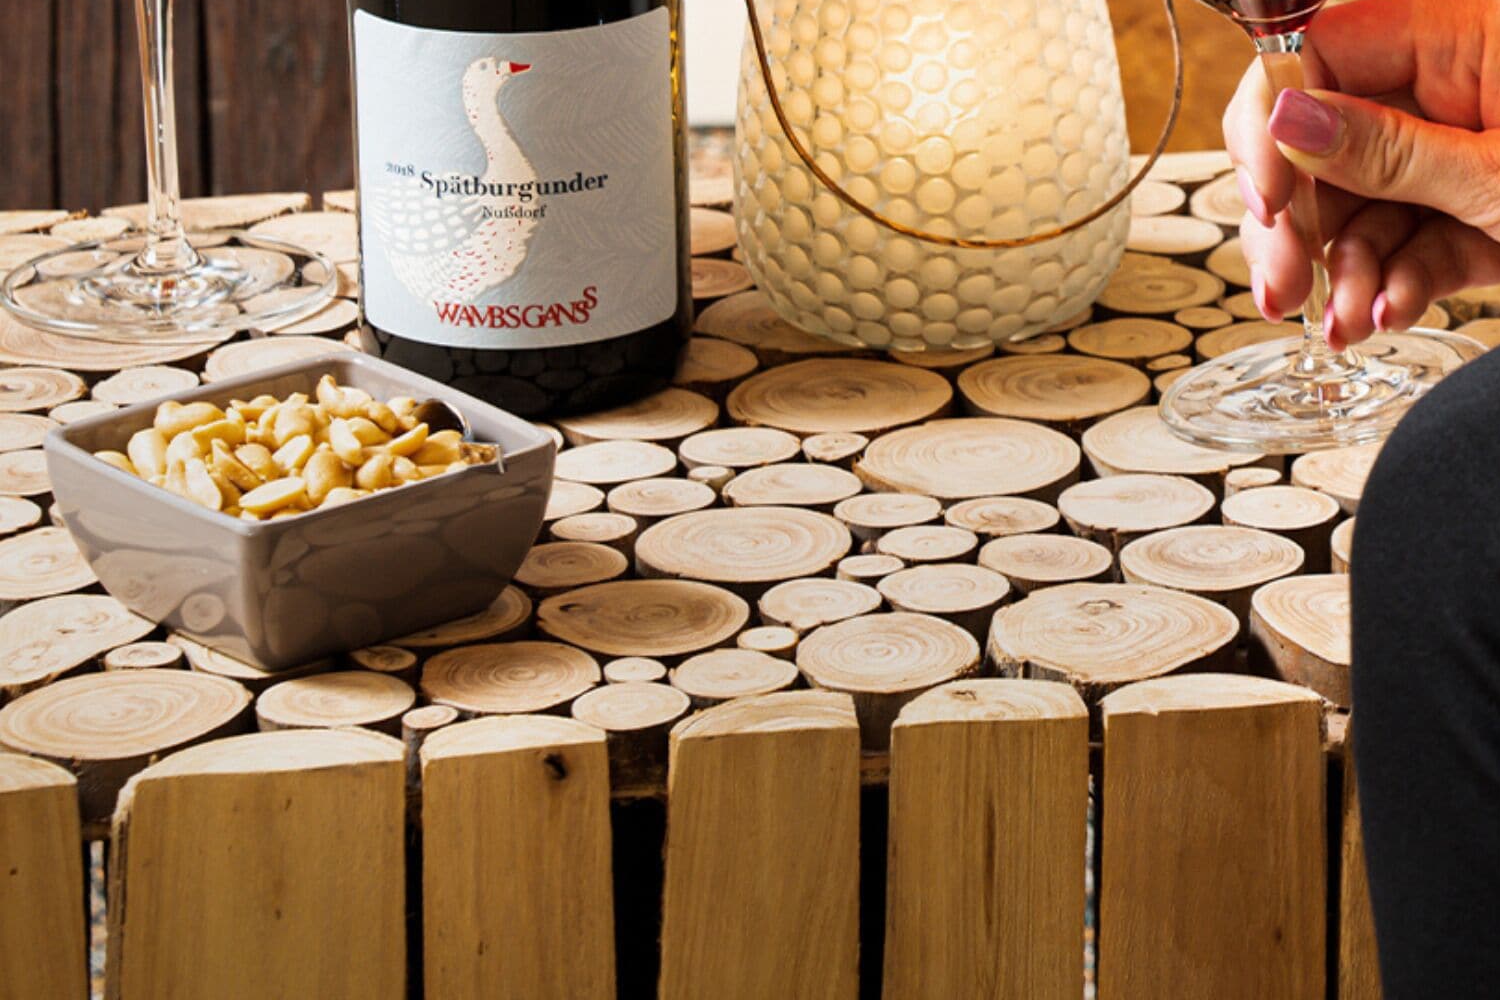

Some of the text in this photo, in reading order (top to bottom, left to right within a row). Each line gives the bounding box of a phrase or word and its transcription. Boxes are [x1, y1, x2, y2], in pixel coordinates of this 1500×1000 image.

[386, 161, 609, 203] 2018 Spätburgunder
[481, 204, 548, 220] Nußdorf
[433, 285, 599, 329] WAMBSGANSS
